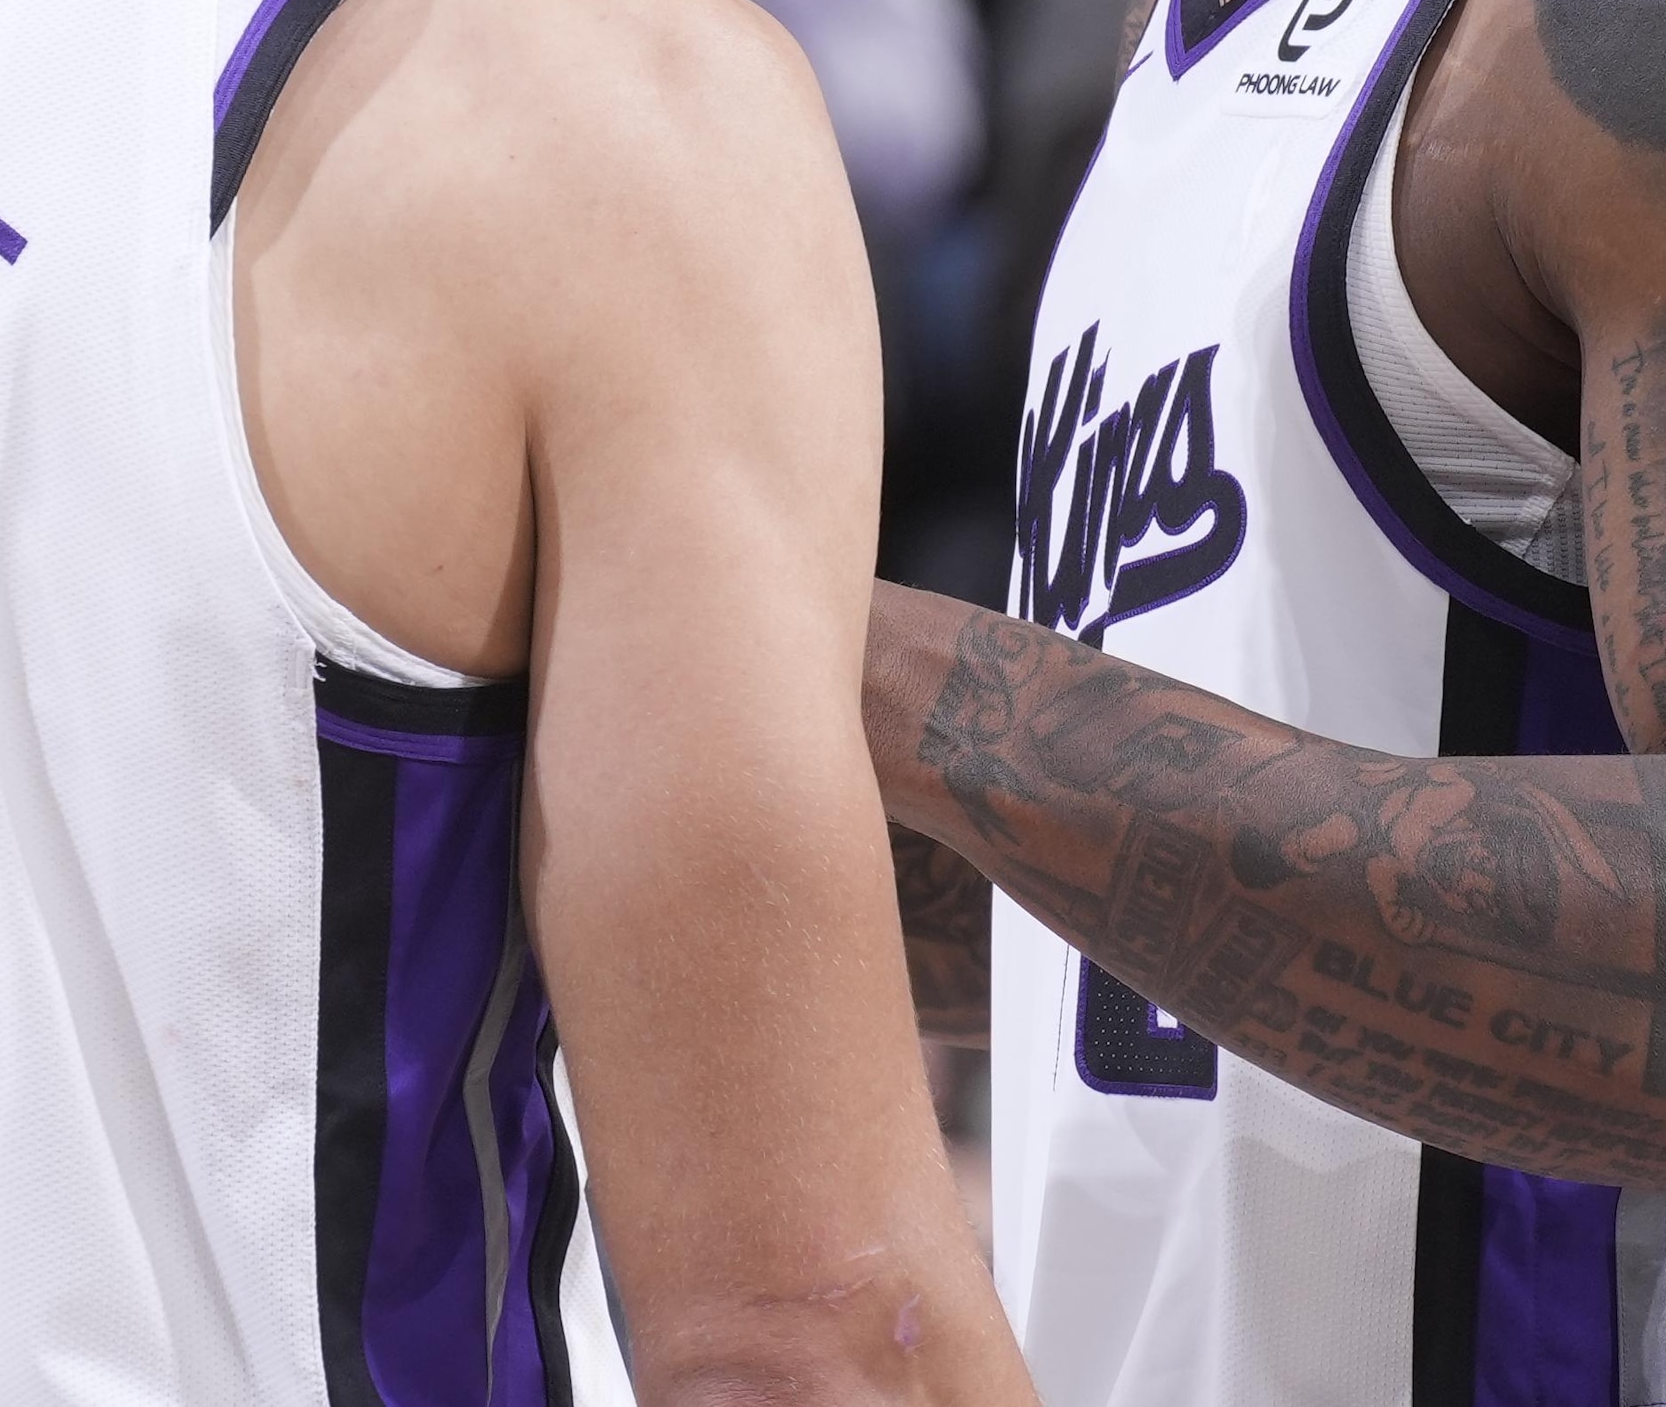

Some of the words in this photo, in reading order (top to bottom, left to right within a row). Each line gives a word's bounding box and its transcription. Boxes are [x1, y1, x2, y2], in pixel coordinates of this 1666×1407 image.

[1235, 73, 1301, 96] PHOONG
[1299, 74, 1341, 97] LAW
[1312, 940, 1475, 1030] BLUE
[1488, 1008, 1633, 1076] CITY
